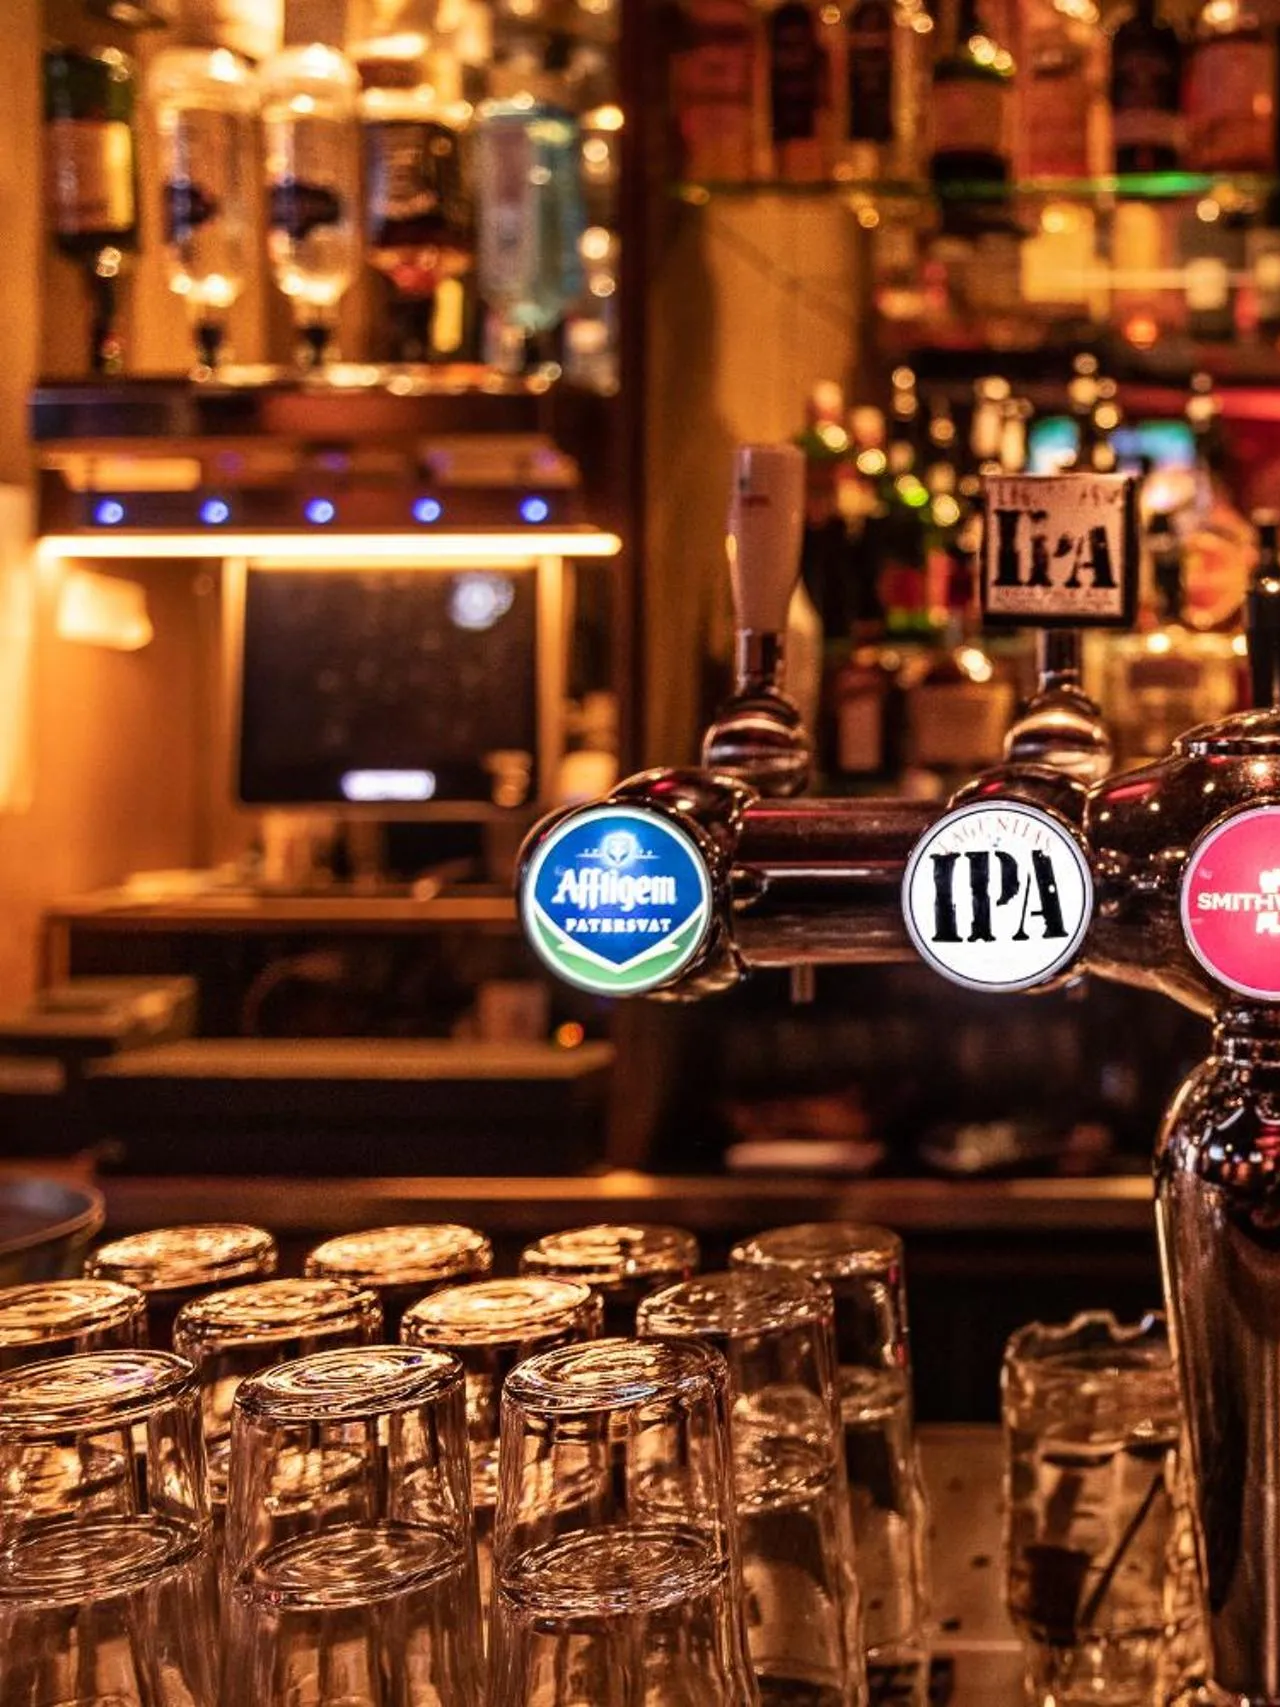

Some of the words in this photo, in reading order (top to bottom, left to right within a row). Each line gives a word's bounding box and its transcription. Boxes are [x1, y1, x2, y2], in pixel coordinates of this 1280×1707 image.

[993, 509, 1117, 588] IPA
[552, 868, 677, 912] Affligem
[930, 850, 1069, 943] IPA
[565, 918, 672, 933] PATERSVAT
